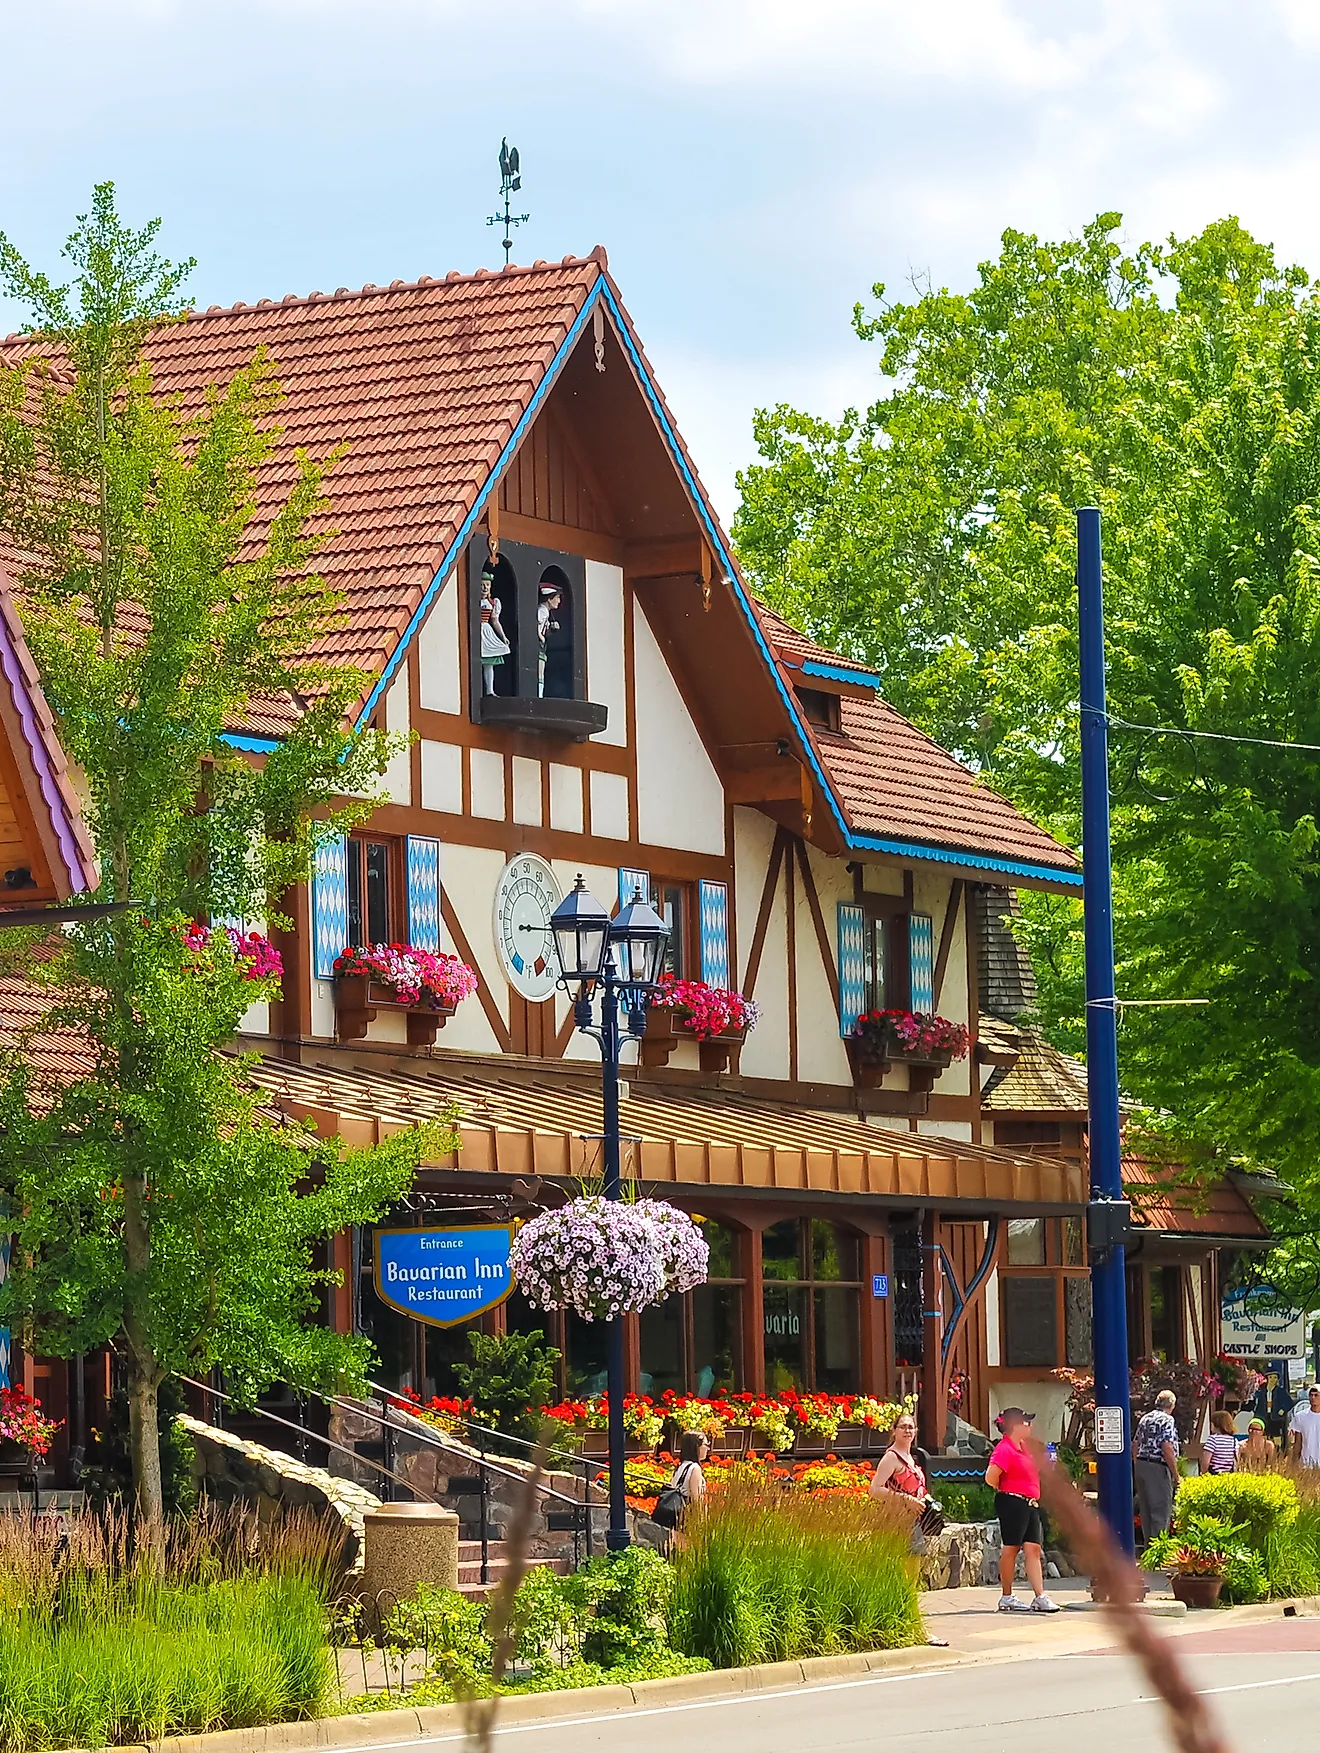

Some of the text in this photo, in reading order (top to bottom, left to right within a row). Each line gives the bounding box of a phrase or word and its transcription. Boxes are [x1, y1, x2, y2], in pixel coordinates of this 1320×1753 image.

[523, 862, 531, 874] 50
[546, 890, 554, 903] 70
[420, 1237, 464, 1250] Entrance
[386, 1256, 504, 1282] Bavarian Inn
[407, 1284, 484, 1302] Restaurant
[764, 1309, 800, 1335] varia
[1223, 1343, 1298, 1355] CASTLE SHOPS
